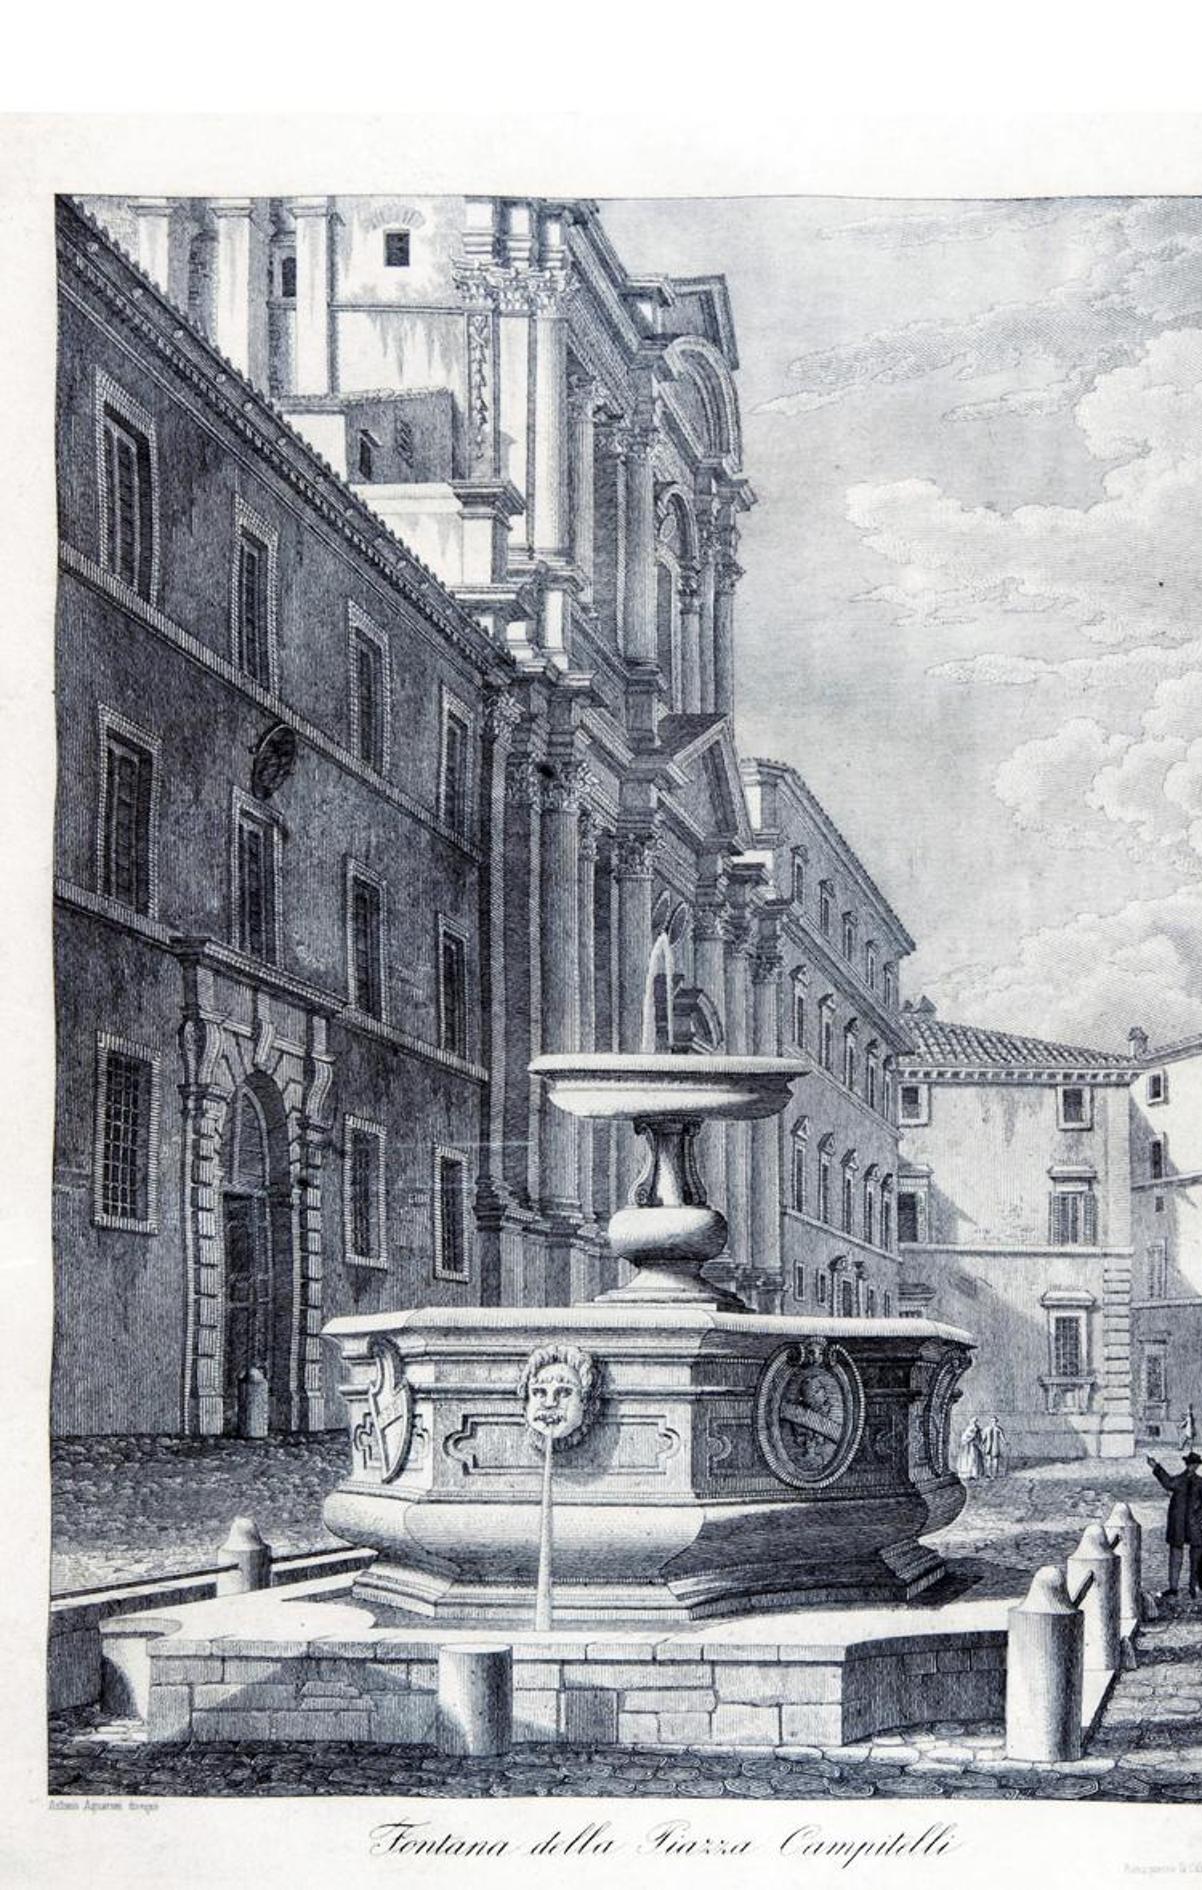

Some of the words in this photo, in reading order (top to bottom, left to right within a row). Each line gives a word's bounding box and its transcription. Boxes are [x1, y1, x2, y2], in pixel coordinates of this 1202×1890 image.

[370, 1818, 509, 1856] Fontana
[530, 1822, 613, 1855] della
[646, 1819, 751, 1855] Piazza
[780, 1823, 957, 1869] Campitelli
